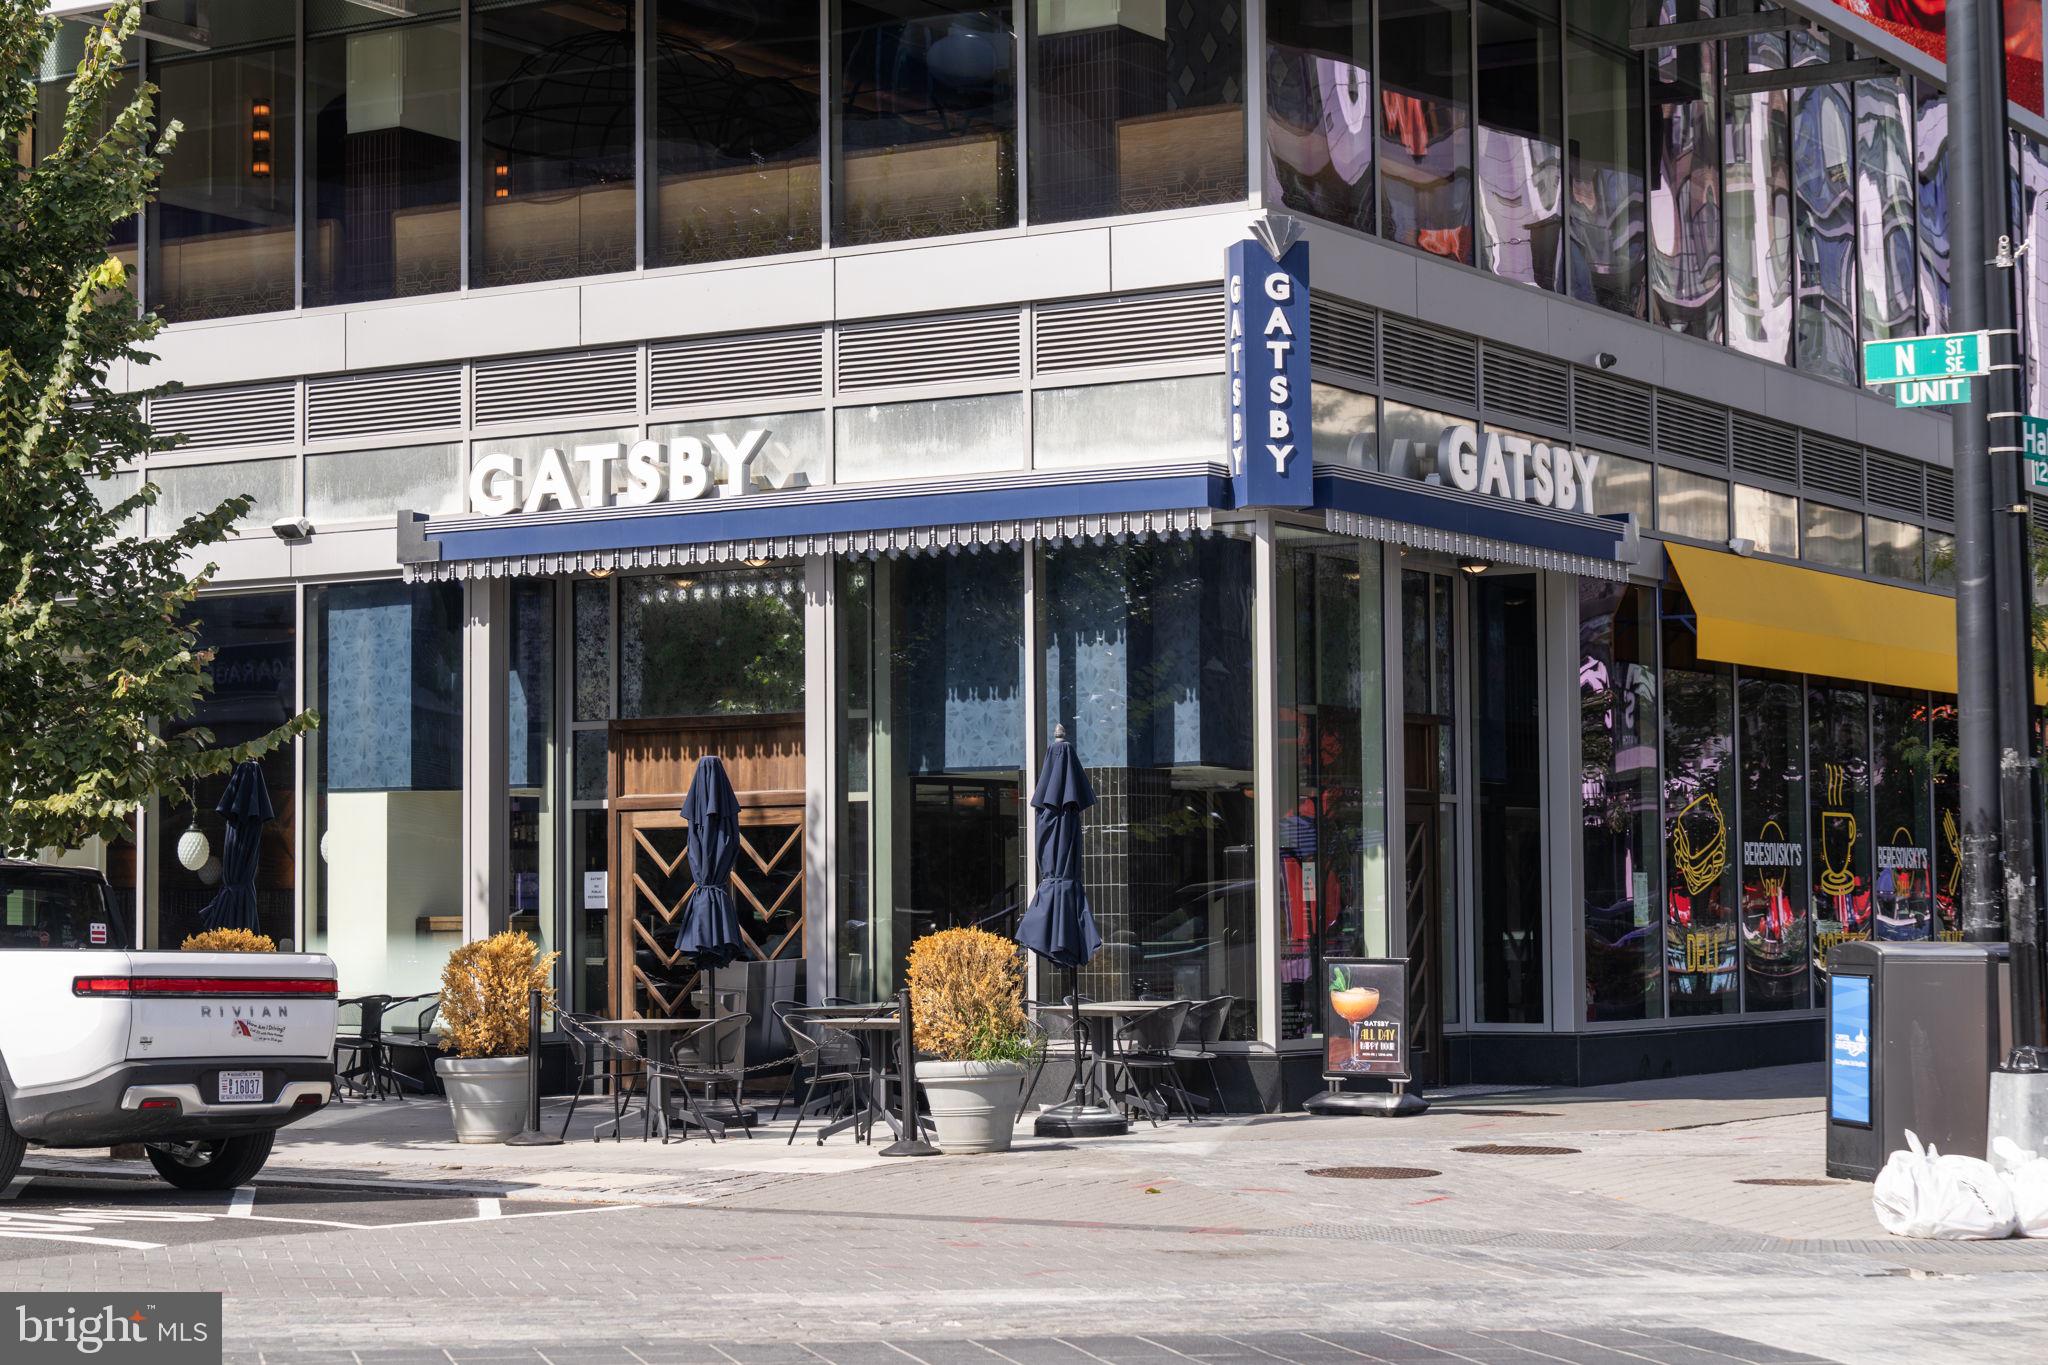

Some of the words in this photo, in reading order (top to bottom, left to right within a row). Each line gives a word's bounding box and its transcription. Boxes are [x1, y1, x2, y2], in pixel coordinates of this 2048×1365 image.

[1895, 344, 1915, 376] N
[1945, 338, 1964, 355] ST
[1945, 355, 1966, 373] SE
[1230, 275, 1243, 475] GATSBY
[1264, 272, 1294, 473] GATSBY
[1900, 378, 1965, 404] UNIT
[2023, 421, 2048, 456] Ha
[470, 428, 772, 517] GATSBY
[1438, 425, 1600, 515] GATSBY
[1744, 841, 1802, 866] BERESOVSKY'S
[1878, 846, 1928, 869] BERESOVSKY'S
[1687, 933, 1719, 972] DELI
[201, 1006, 287, 1018] RIVIAN
[1360, 1028, 1376, 1041] ALL
[1377, 1028, 1395, 1041] DAY
[235, 1079, 260, 1095] 16037
